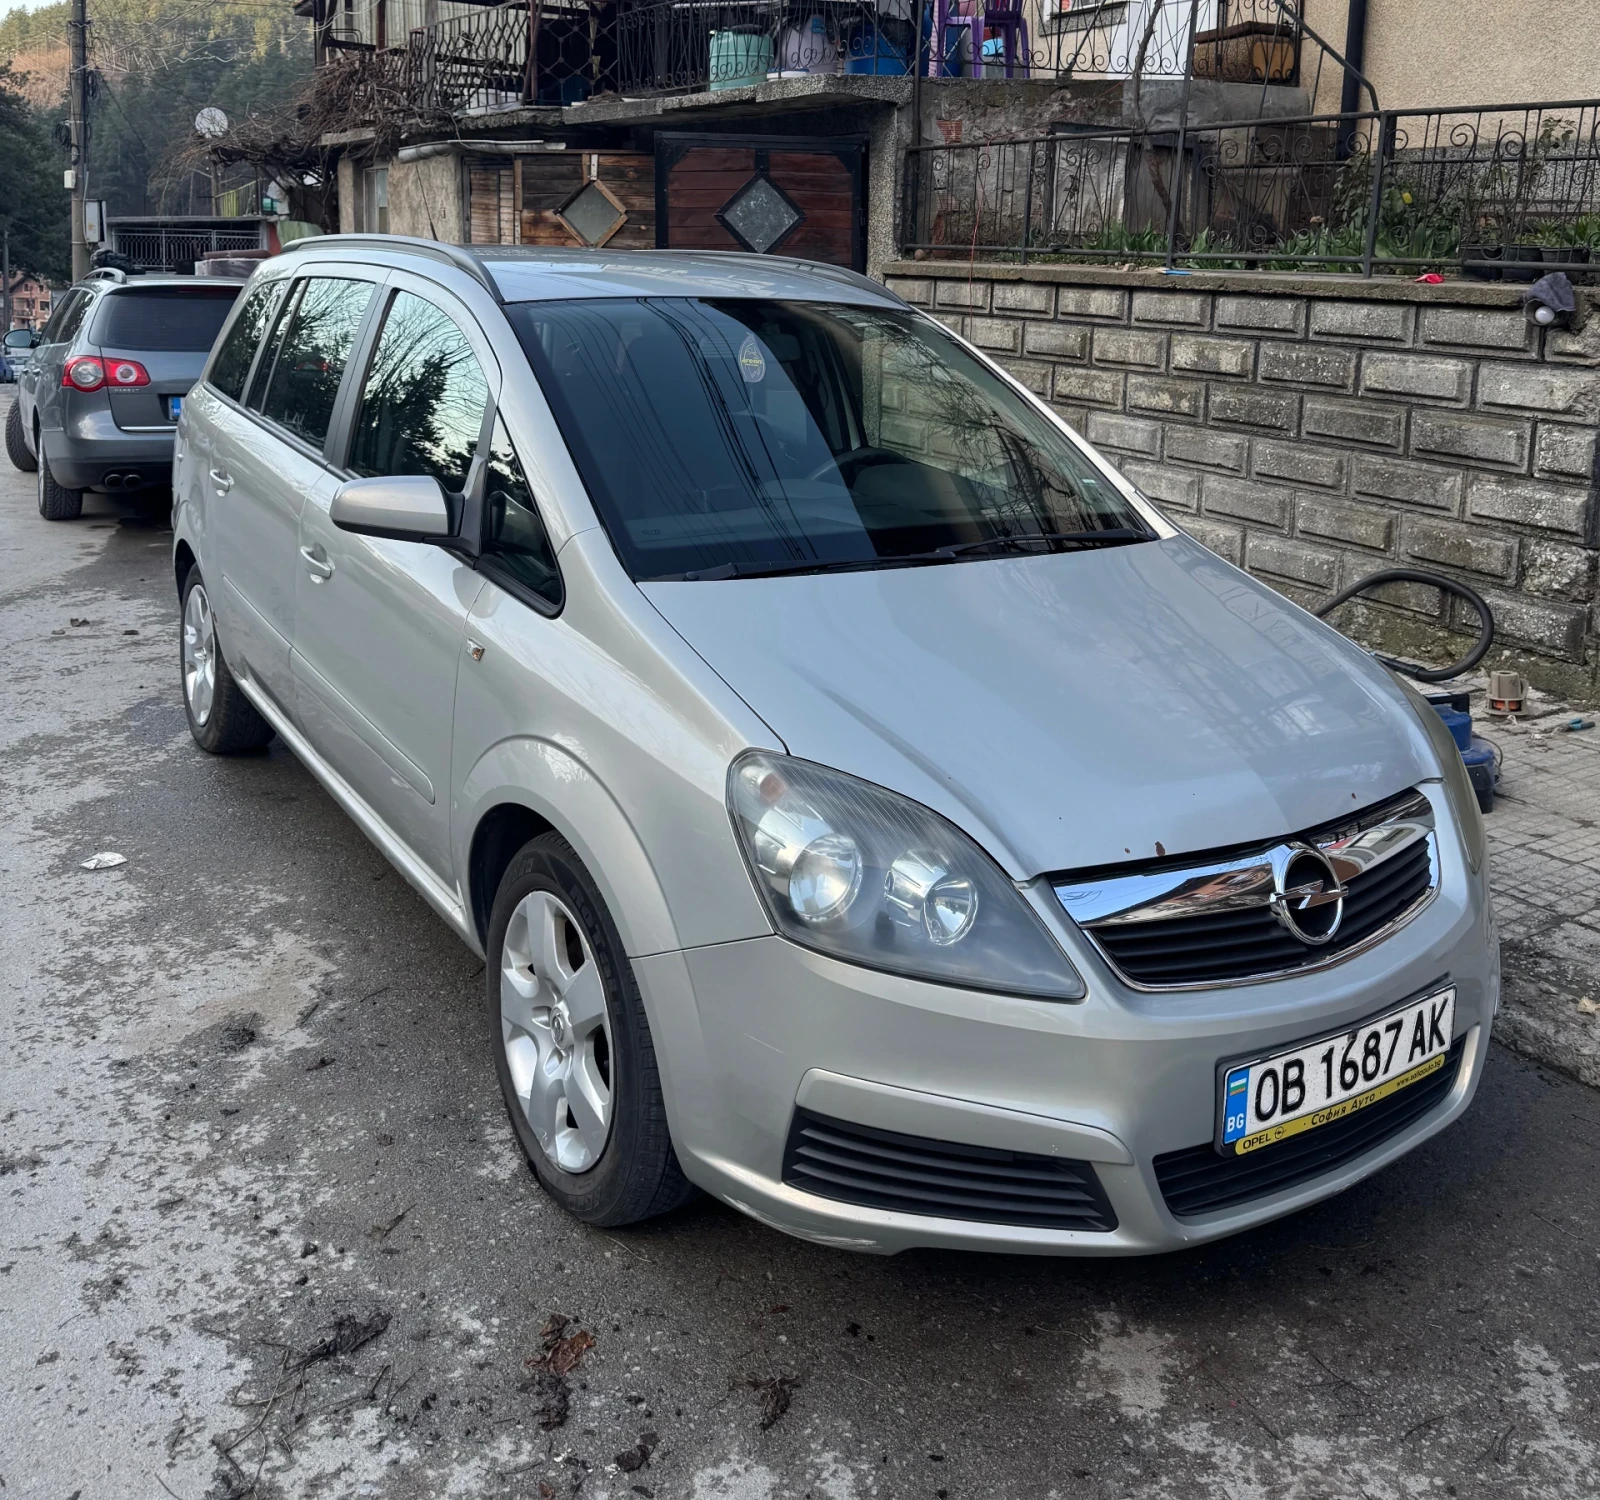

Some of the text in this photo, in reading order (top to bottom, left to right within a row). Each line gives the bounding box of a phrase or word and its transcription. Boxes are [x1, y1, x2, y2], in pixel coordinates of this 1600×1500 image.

[1254, 996, 1450, 1122] OB 1687 AK
[1227, 1112, 1245, 1133] BG
[1311, 1093, 1376, 1126] София Ауто
[1242, 1133, 1272, 1150] OPEL
